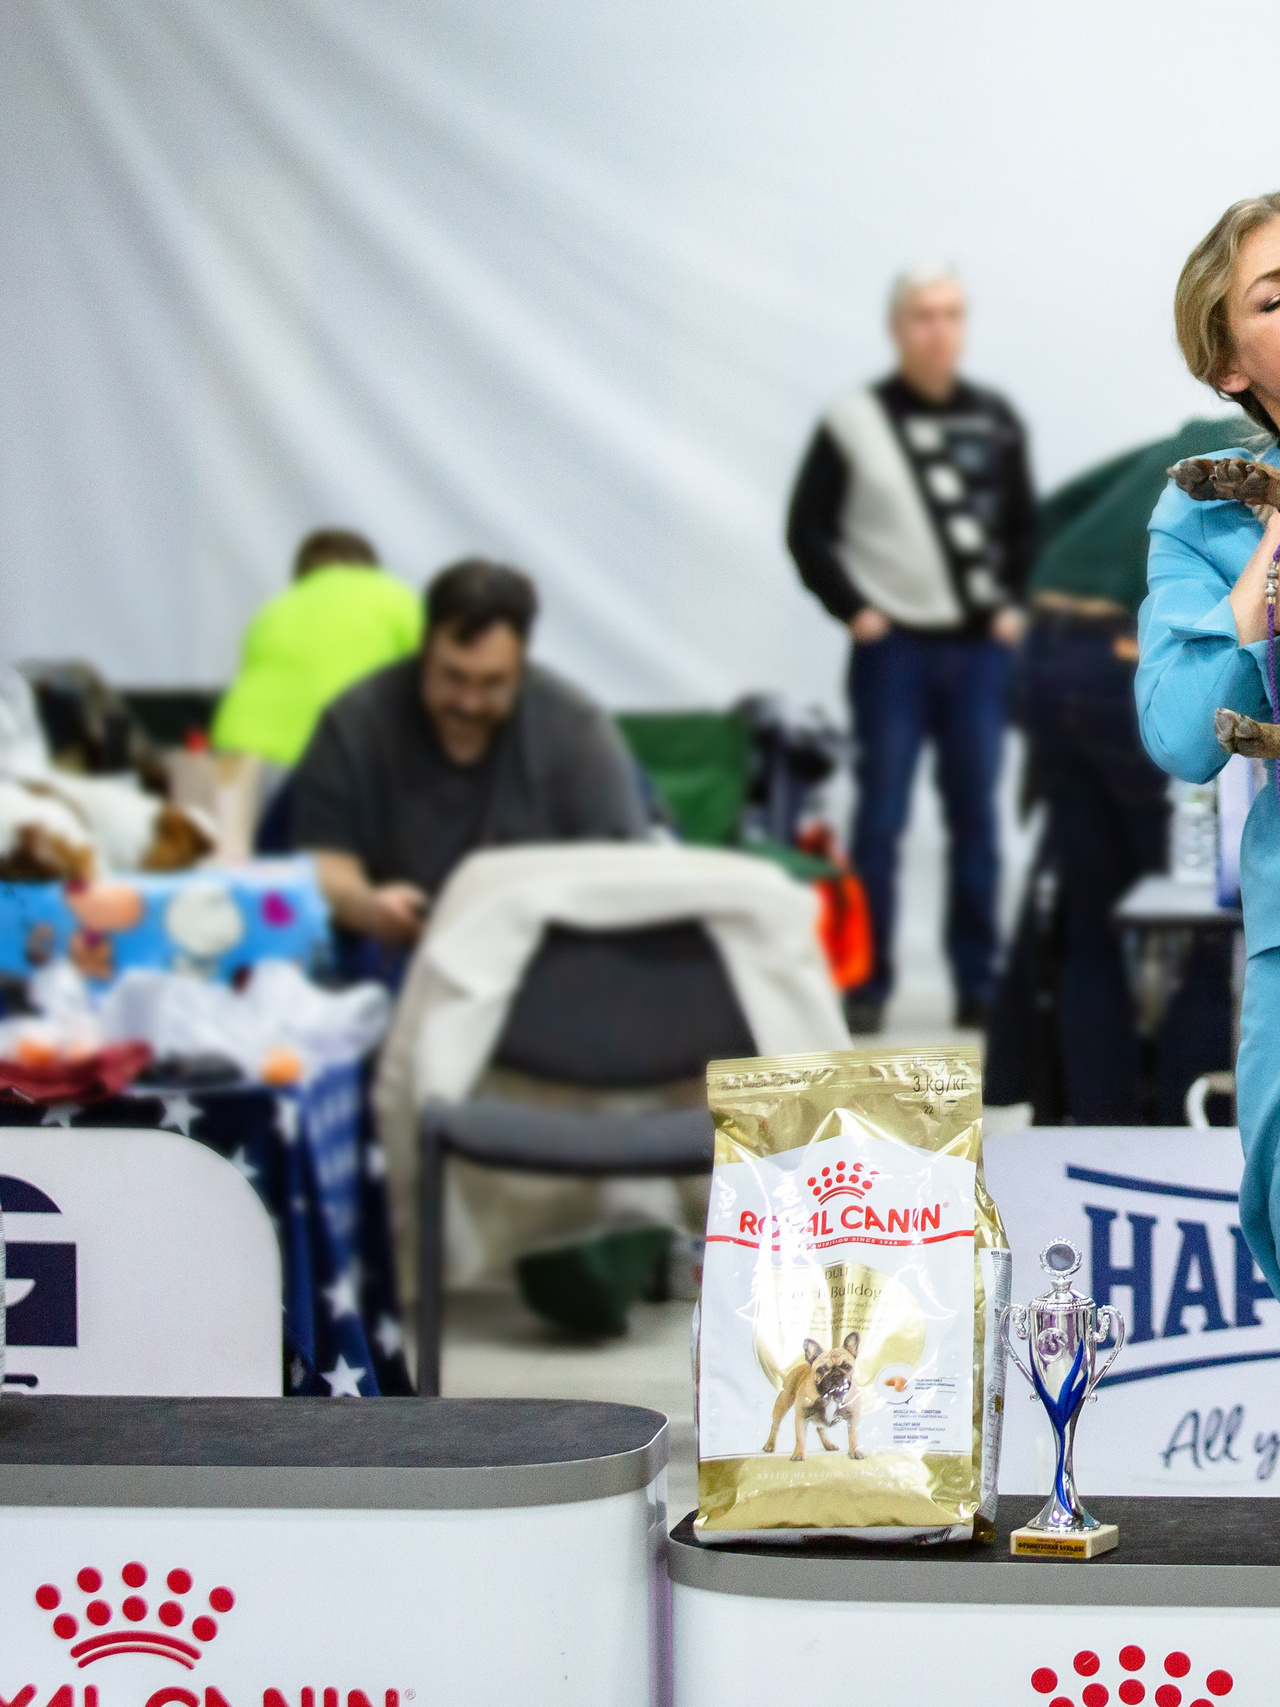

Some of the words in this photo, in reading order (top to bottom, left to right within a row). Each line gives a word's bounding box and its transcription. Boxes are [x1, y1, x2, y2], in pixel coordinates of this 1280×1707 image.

[912, 1075, 921, 1092] 3
[840, 1203, 941, 1234] CANIN
[851, 1236, 875, 1244] SINCE
[824, 1267, 848, 1280] DULT
[1083, 1203, 1275, 1352] HAP
[831, 1283, 882, 1302] Bulldog
[1160, 1403, 1245, 1470] All
